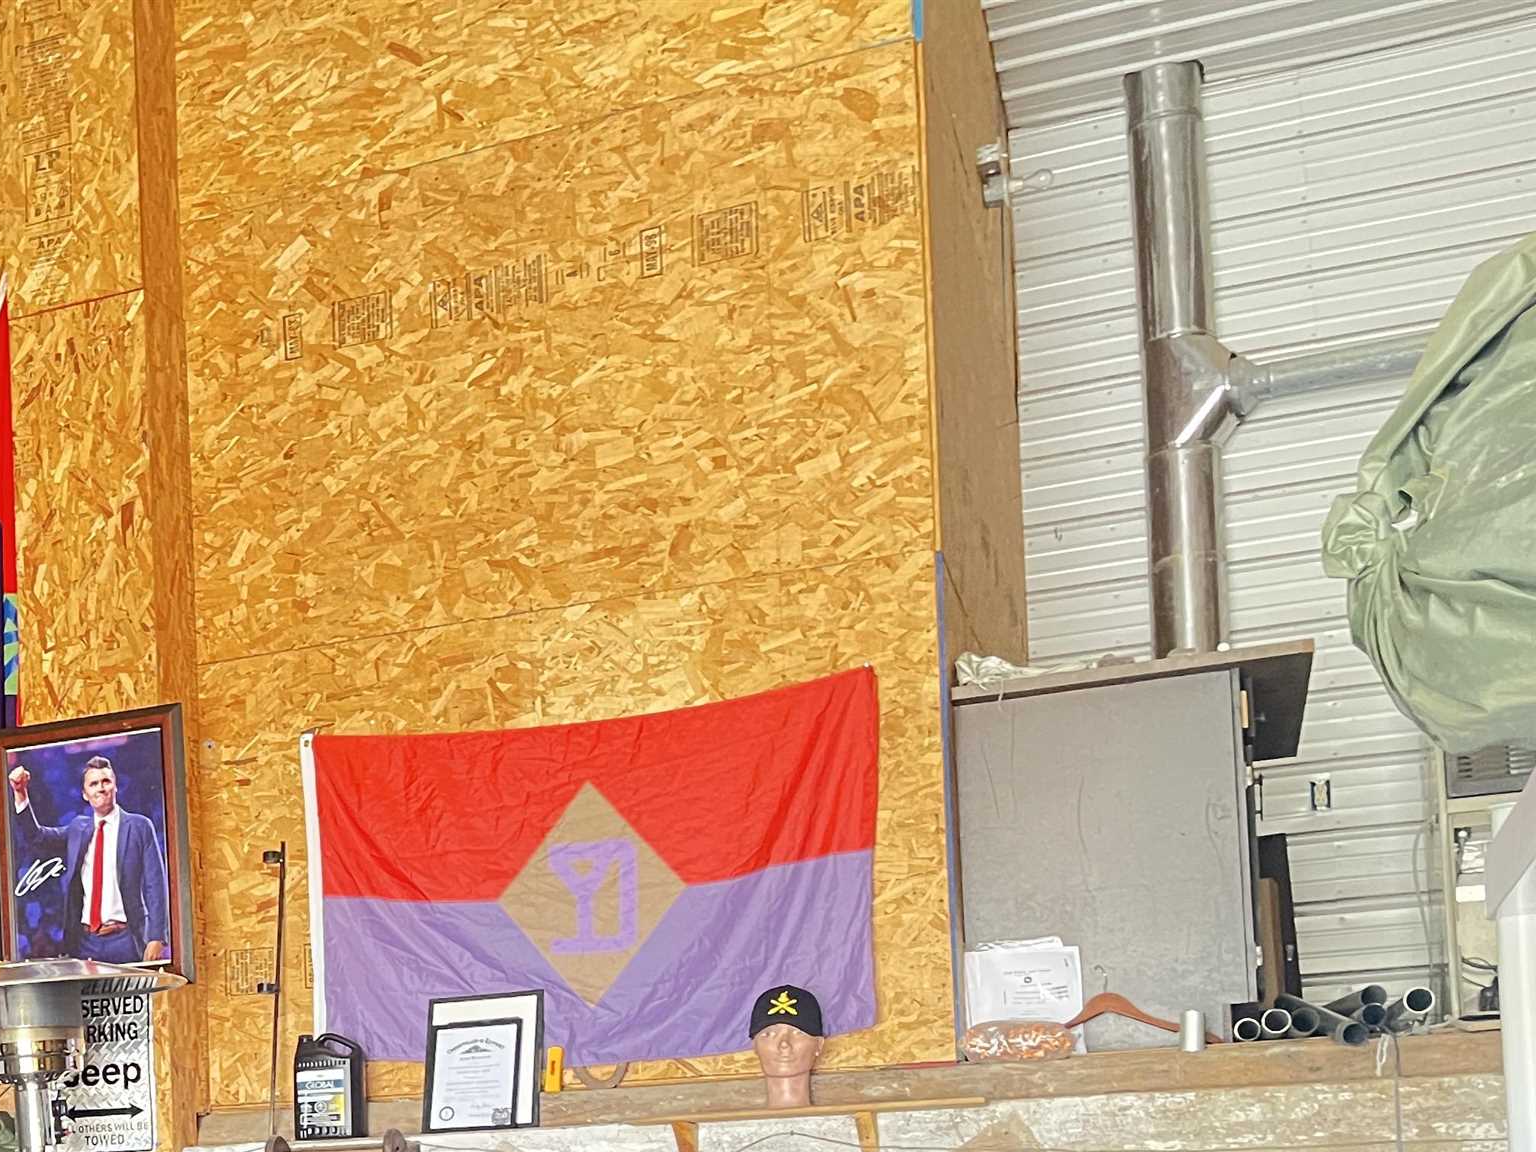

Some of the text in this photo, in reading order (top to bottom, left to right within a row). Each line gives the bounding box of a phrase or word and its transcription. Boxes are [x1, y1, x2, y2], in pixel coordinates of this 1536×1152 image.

[80, 995, 144, 1018] SERVED
[87, 1021, 138, 1044] RKING
[84, 1134, 125, 1146] TOWED
